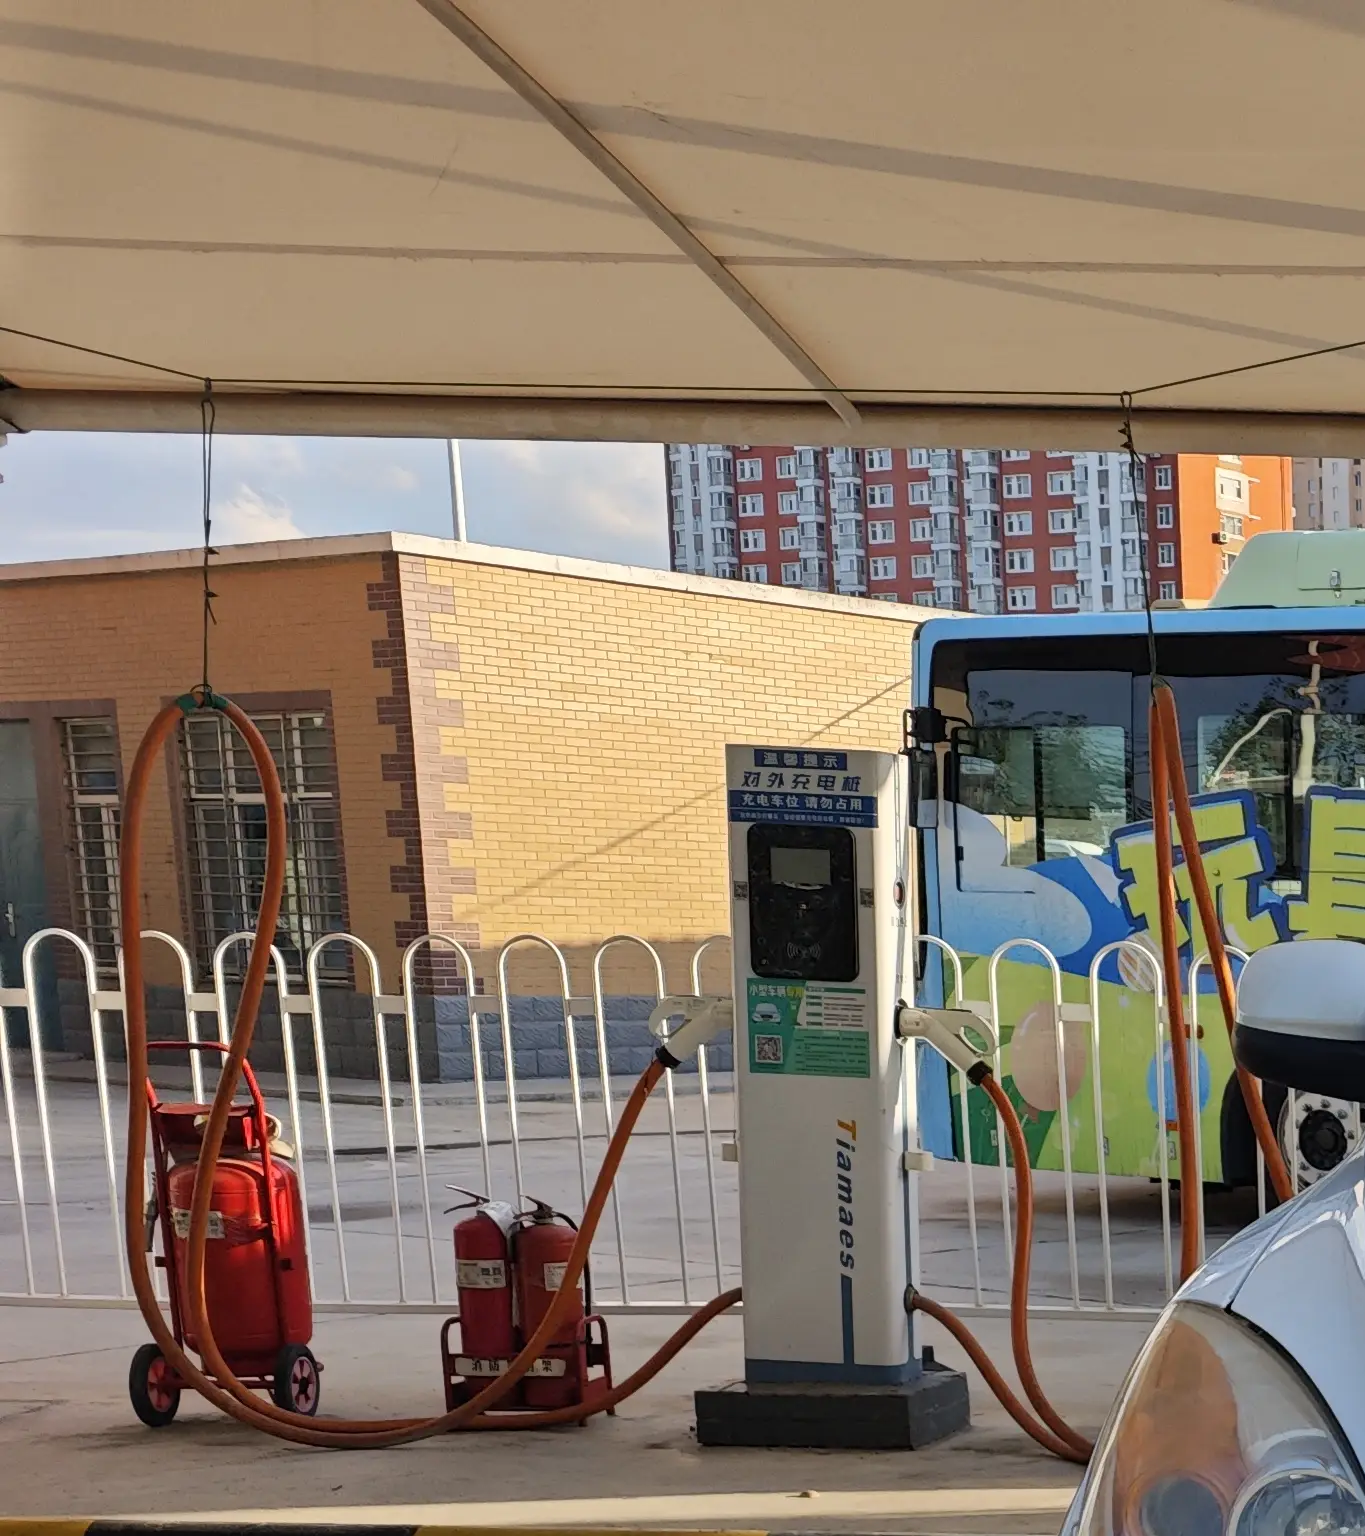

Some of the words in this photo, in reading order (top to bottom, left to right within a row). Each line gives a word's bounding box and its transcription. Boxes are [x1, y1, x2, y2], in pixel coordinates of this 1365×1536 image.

[763, 751, 838, 768] 温馨提示
[741, 770, 862, 793] 对外充电桩
[742, 792, 800, 808] 充电车位
[805, 795, 863, 811] 请勿占用
[836, 1118, 857, 1270] Tiamaes
[471, 1359, 553, 1373] 消防架
